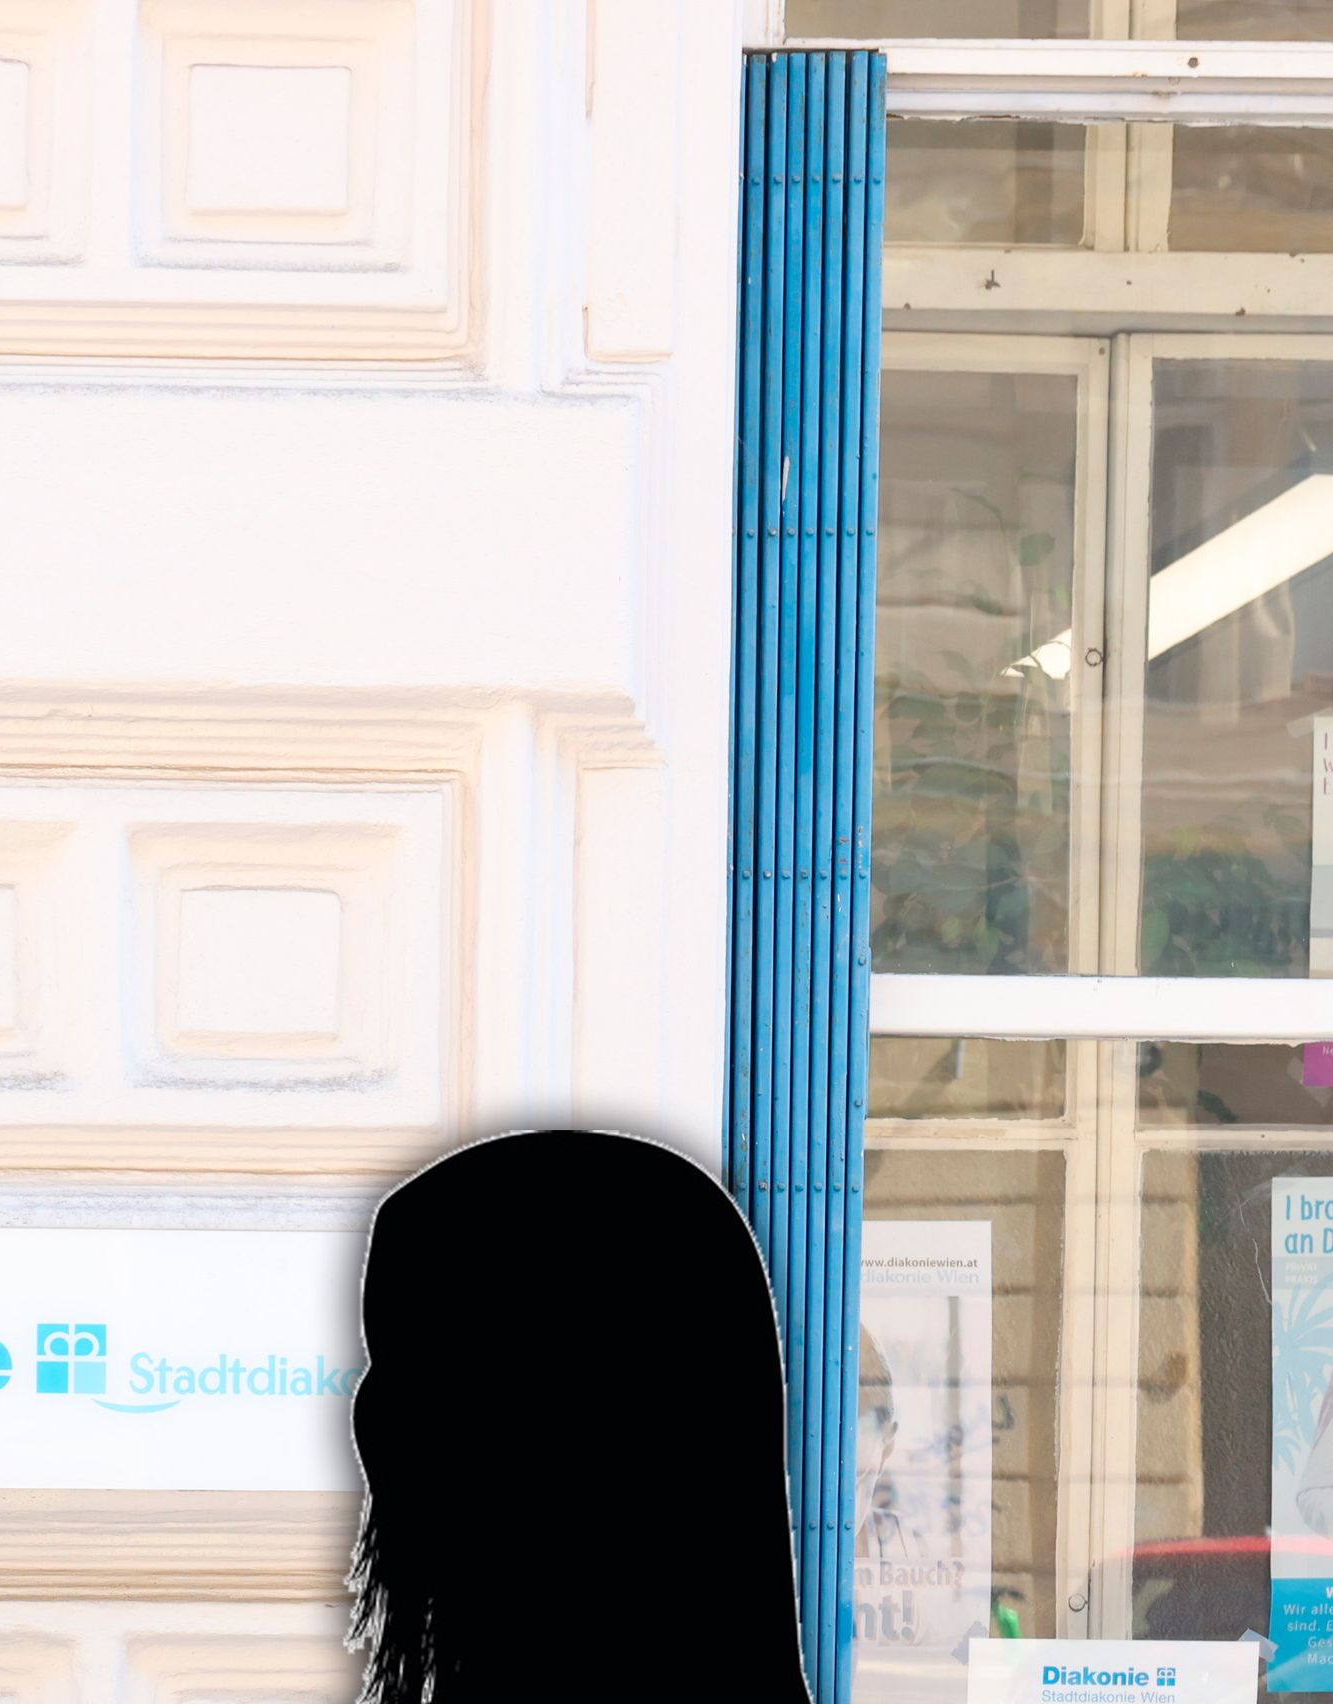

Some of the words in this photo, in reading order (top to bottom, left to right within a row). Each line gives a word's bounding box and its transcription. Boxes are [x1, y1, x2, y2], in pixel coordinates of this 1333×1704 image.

[1284, 1232, 1314, 1254] an
[880, 1559, 966, 1586] Bauch?
[1283, 1603, 1307, 1616] Wir
[1287, 1619, 1321, 1632] sind.
[1042, 1666, 1150, 1687] Diakonie
[1042, 1690, 1135, 1704] Stadtdiakonie
[1141, 1691, 1176, 1704] Wien
